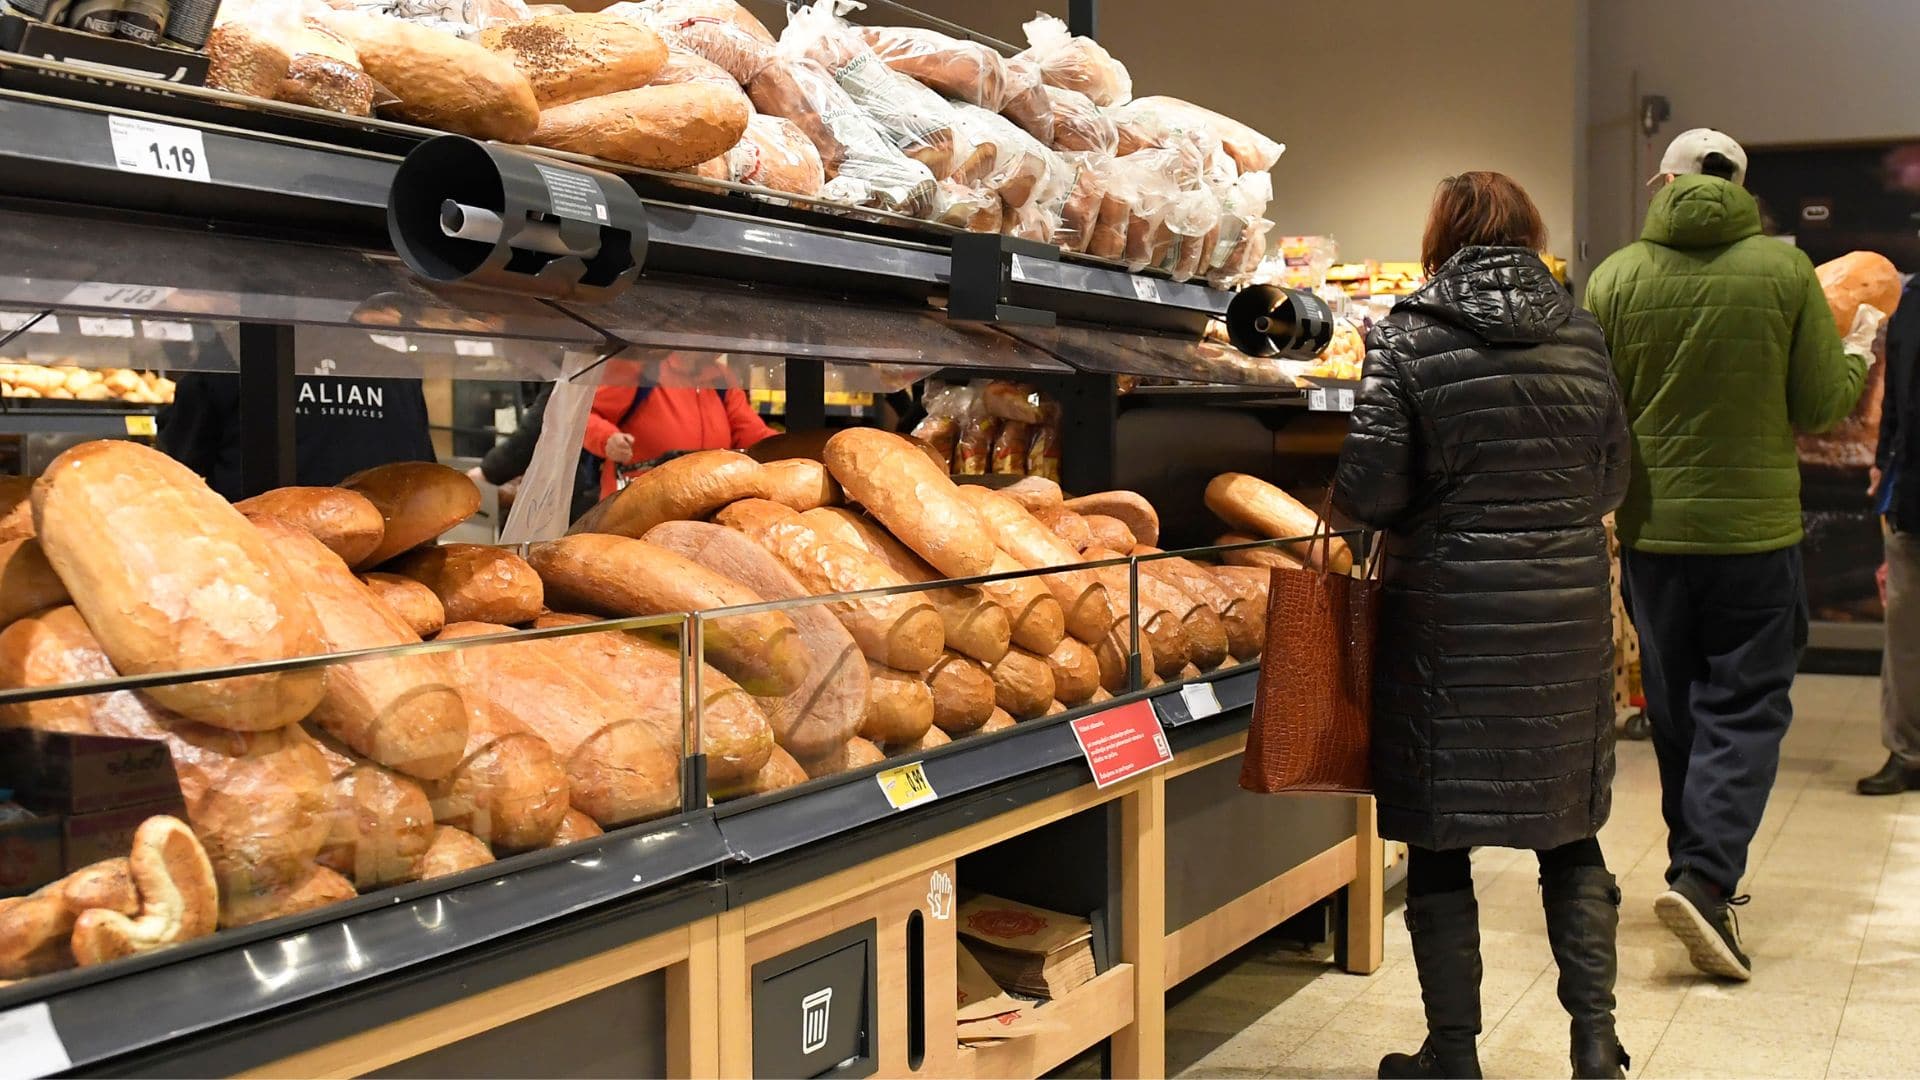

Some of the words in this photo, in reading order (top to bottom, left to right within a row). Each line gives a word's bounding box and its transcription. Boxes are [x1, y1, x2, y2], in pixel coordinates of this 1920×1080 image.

[84, 16, 117, 33] NESC
[149, 142, 195, 173] 1.19
[298, 382, 383, 407] ALIAN
[295, 406, 310, 415] AL
[321, 407, 384, 419] SERVICES
